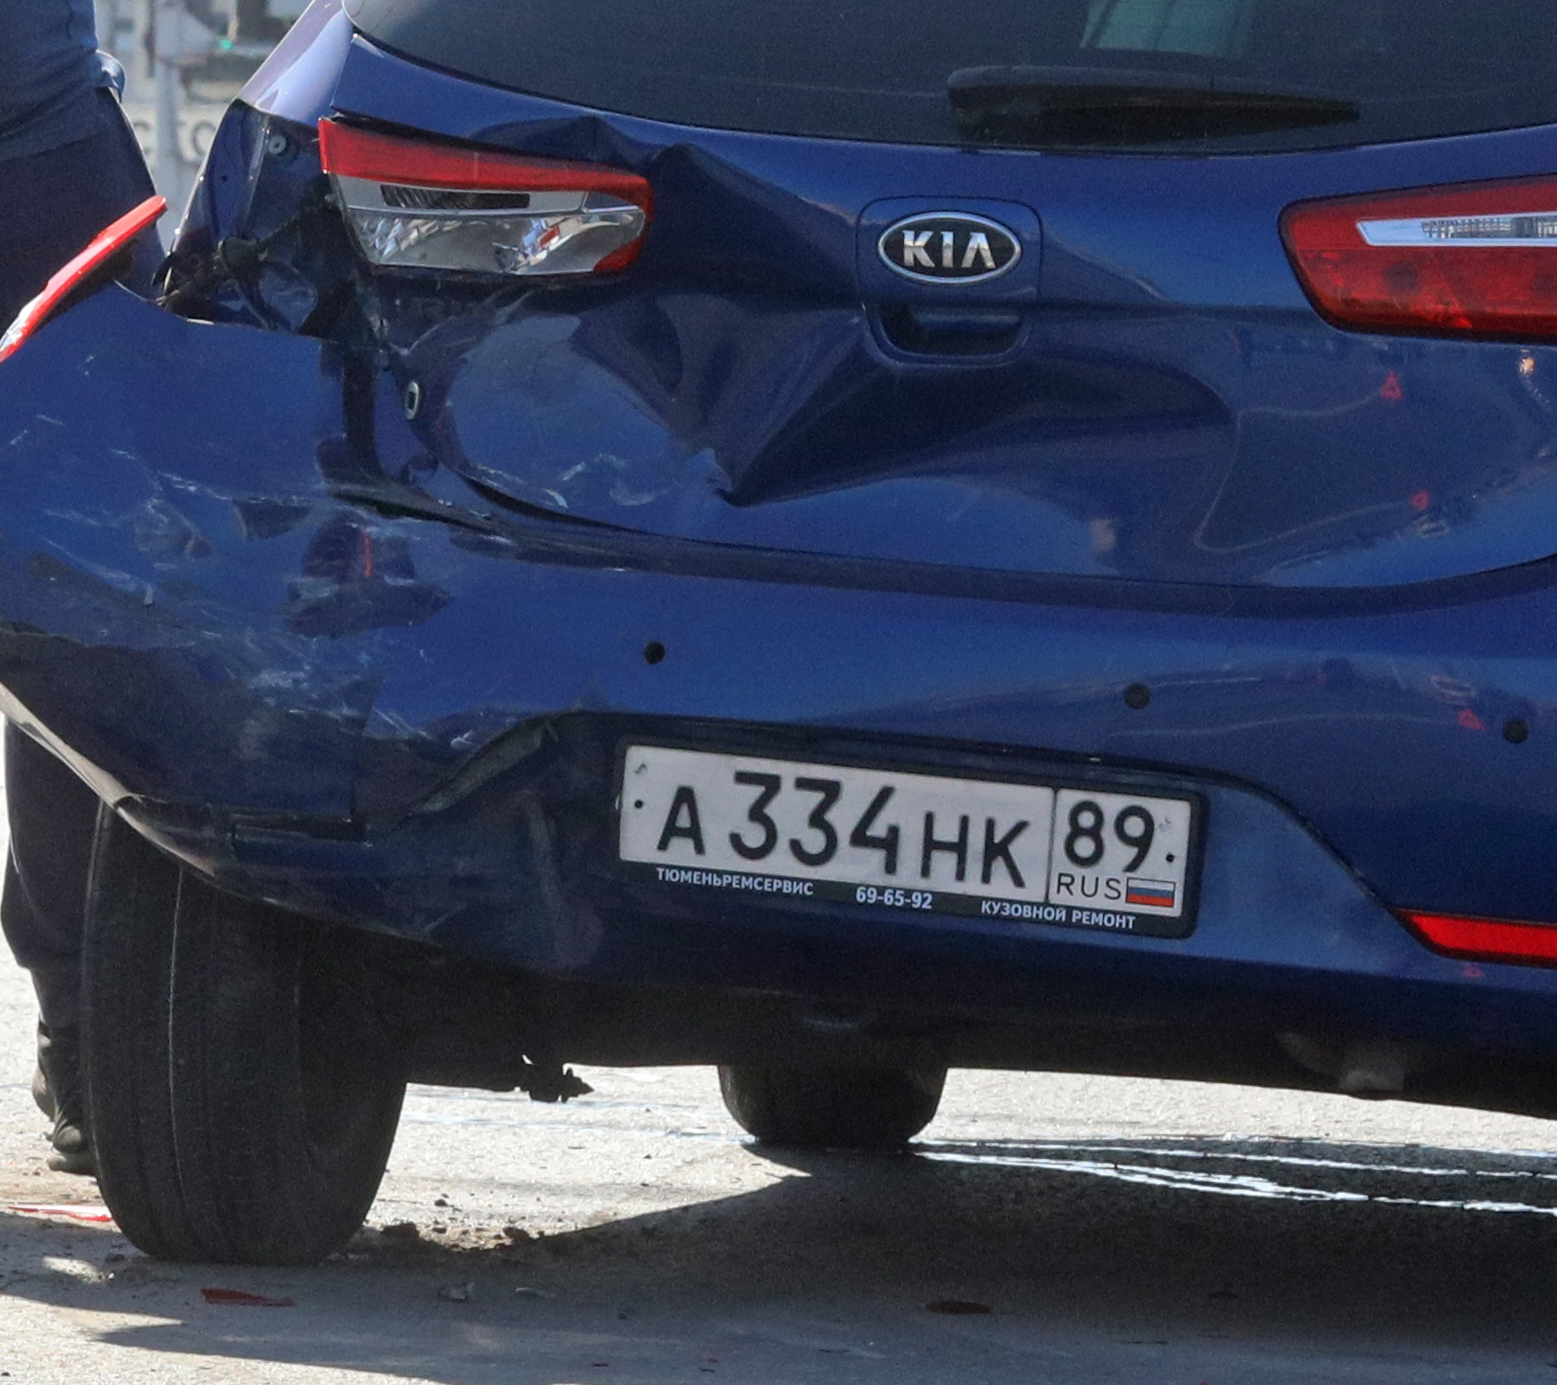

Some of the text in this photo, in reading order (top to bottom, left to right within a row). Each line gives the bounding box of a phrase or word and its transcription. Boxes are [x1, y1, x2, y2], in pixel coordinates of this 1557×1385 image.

[902, 230, 997, 269] KIA
[656, 770, 1030, 889] А334НК
[1063, 799, 1155, 873] 89
[656, 867, 814, 896] ТЮМЕНЬРЕМСЕРВИС
[1056, 872, 1122, 901] RUS
[855, 886, 933, 910] 69-65-92
[981, 900, 1136, 929] КУЗОВНОЙ РЕМОНТ
